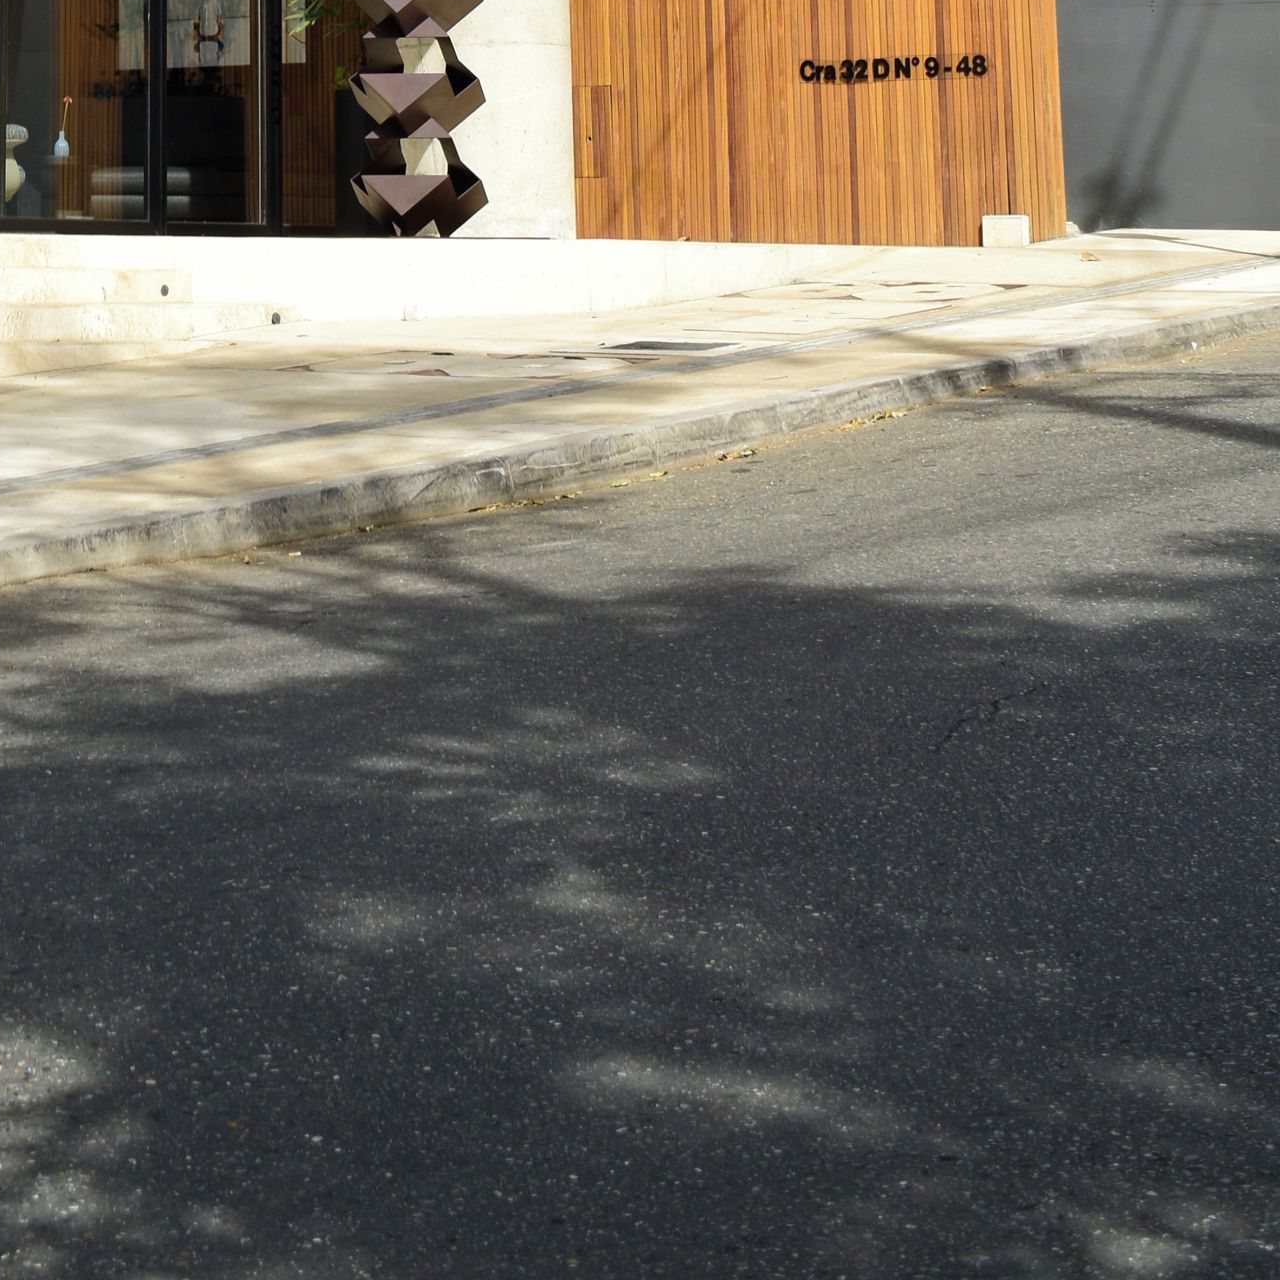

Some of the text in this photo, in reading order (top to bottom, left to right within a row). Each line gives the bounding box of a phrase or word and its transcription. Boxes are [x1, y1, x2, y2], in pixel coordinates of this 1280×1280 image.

[799, 59, 836, 82] Cra
[840, 58, 868, 82] 32
[956, 54, 987, 77] 48
